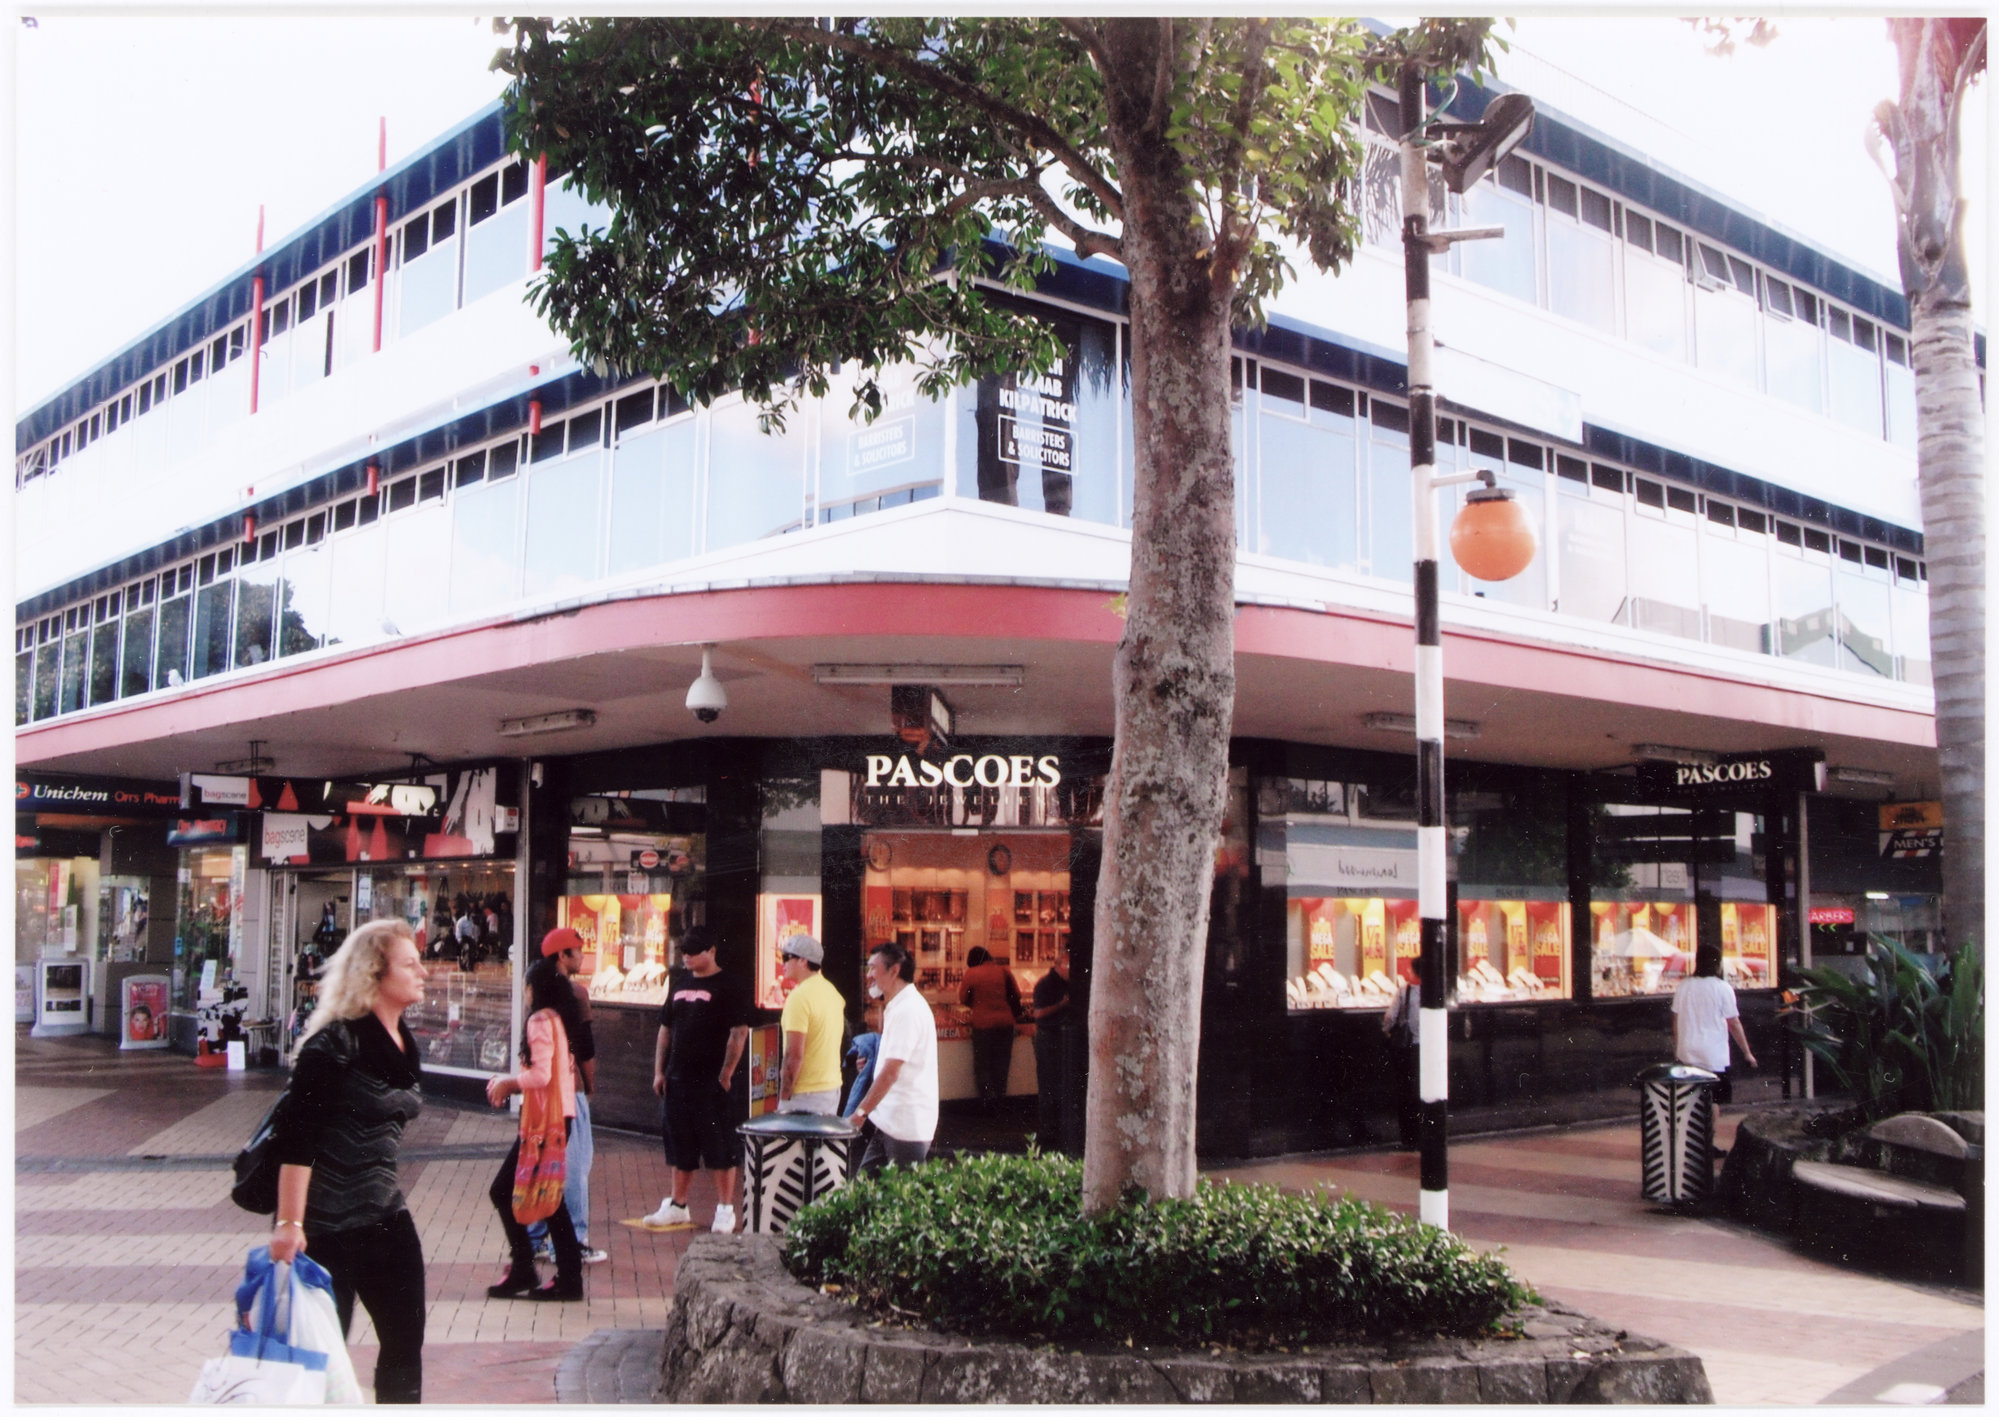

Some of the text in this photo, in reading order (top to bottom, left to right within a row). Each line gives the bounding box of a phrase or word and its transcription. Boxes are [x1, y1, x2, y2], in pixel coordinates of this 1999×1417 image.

[1016, 370, 1063, 398] NAB
[1000, 388, 1077, 423] KILPATRICK
[1012, 424, 1066, 450] BARRISTERS
[1007, 441, 1071, 467] & SOLICITORS
[865, 755, 1061, 787] PASCOES
[1676, 761, 1772, 785] PASCOES
[33, 784, 108, 802] Unichem
[203, 789, 247, 800] bagscene
[867, 795, 905, 805] THE
[264, 828, 306, 849] bagscene
[1893, 836, 1936, 850] MEN'S
[1310, 943, 1334, 959] SALE
[1534, 942, 1560, 956] SALE
